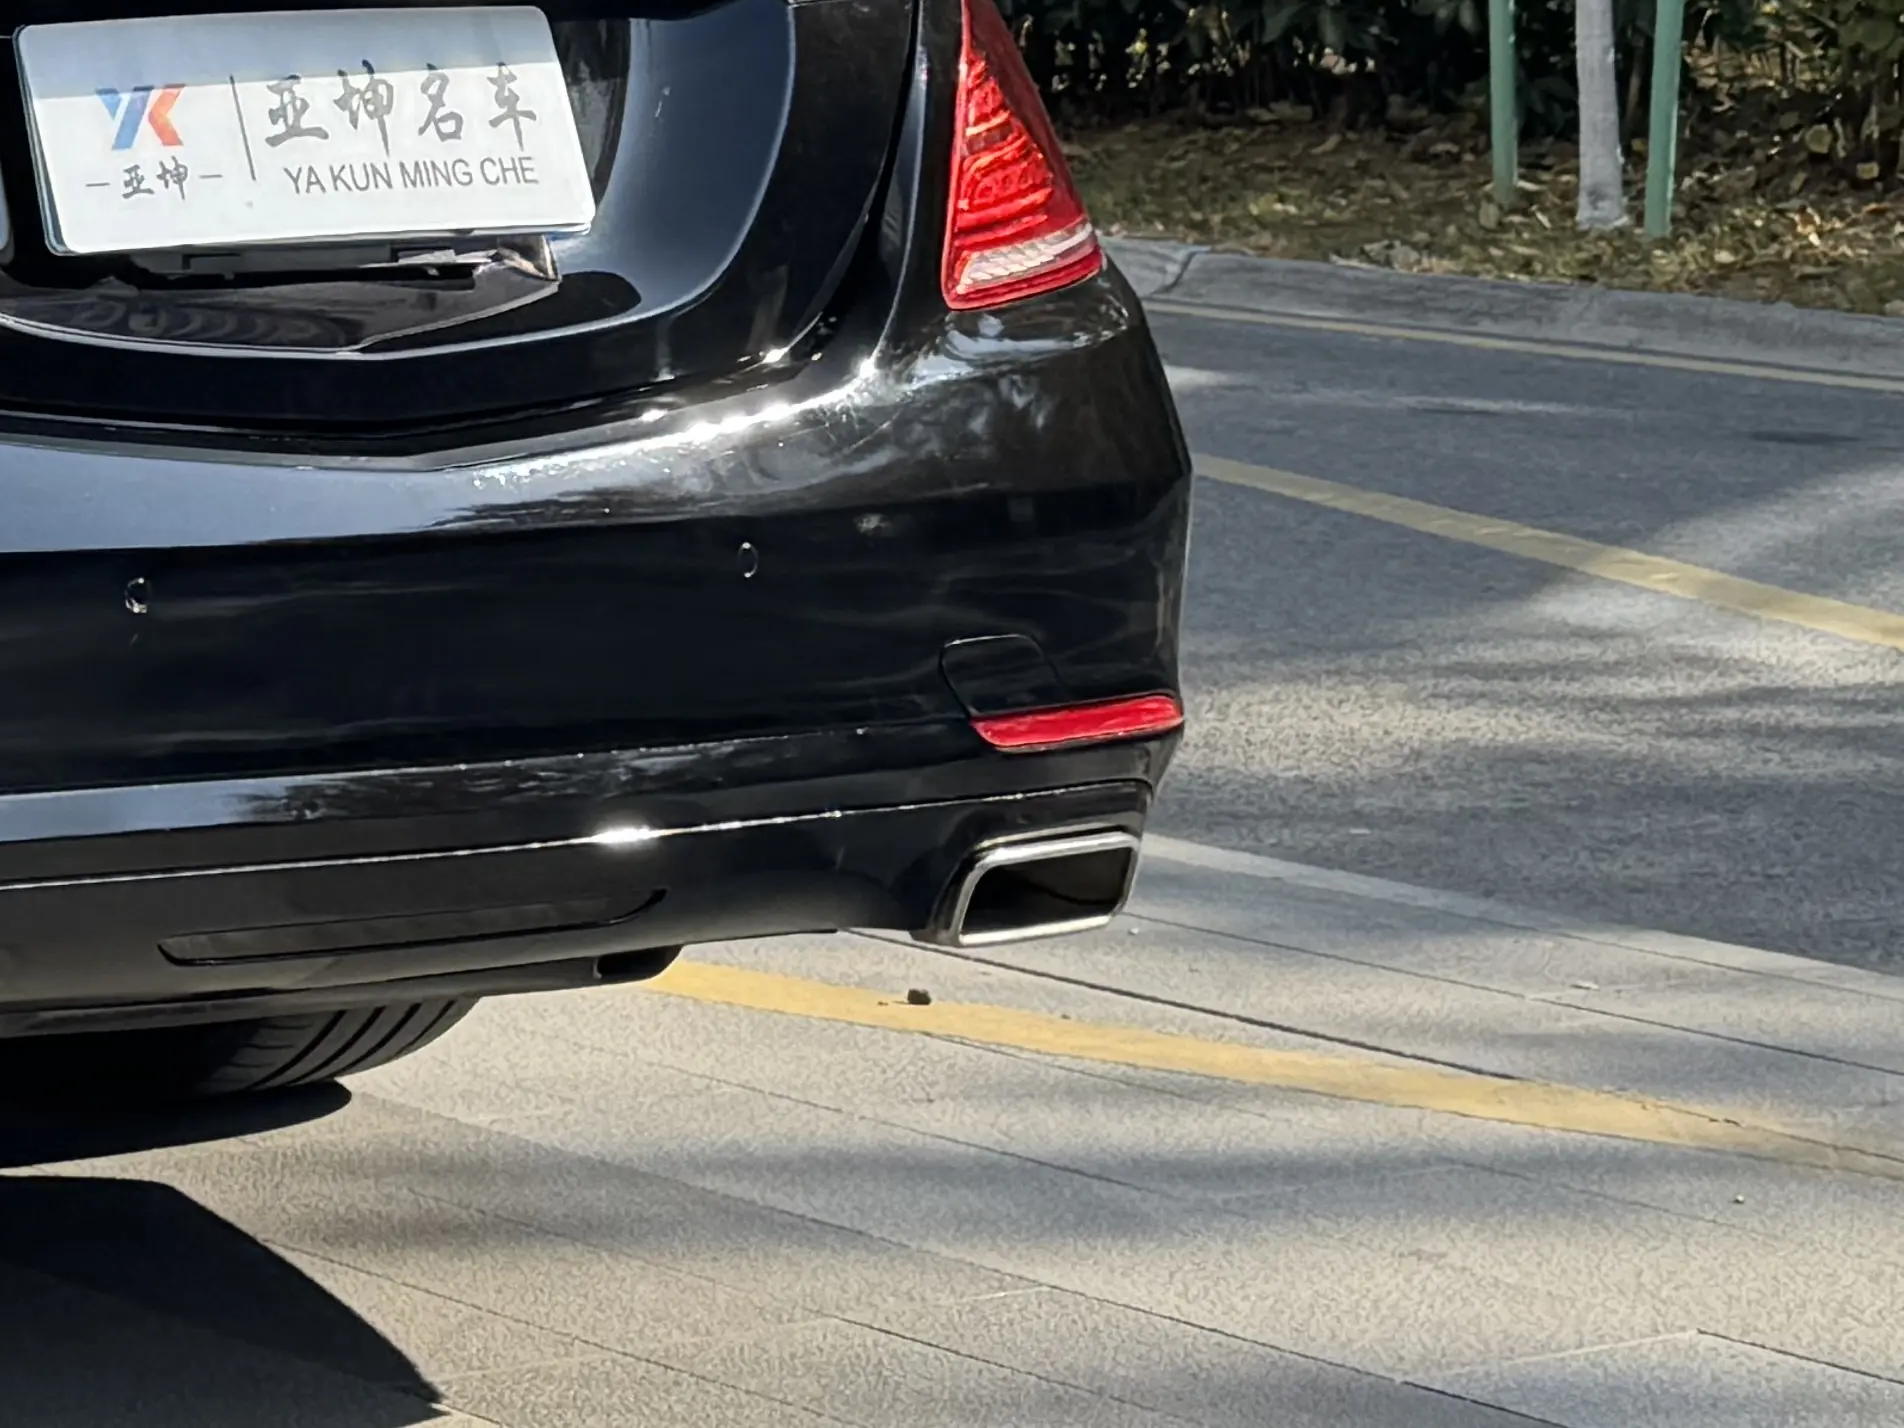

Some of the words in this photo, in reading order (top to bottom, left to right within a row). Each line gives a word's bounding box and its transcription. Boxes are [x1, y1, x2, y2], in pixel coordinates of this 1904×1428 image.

[265, 59, 537, 157] 亚坤名车
[283, 166, 326, 195] YA
[329, 163, 394, 193] KUN
[399, 158, 473, 189] MING
[480, 156, 540, 185] CHE
